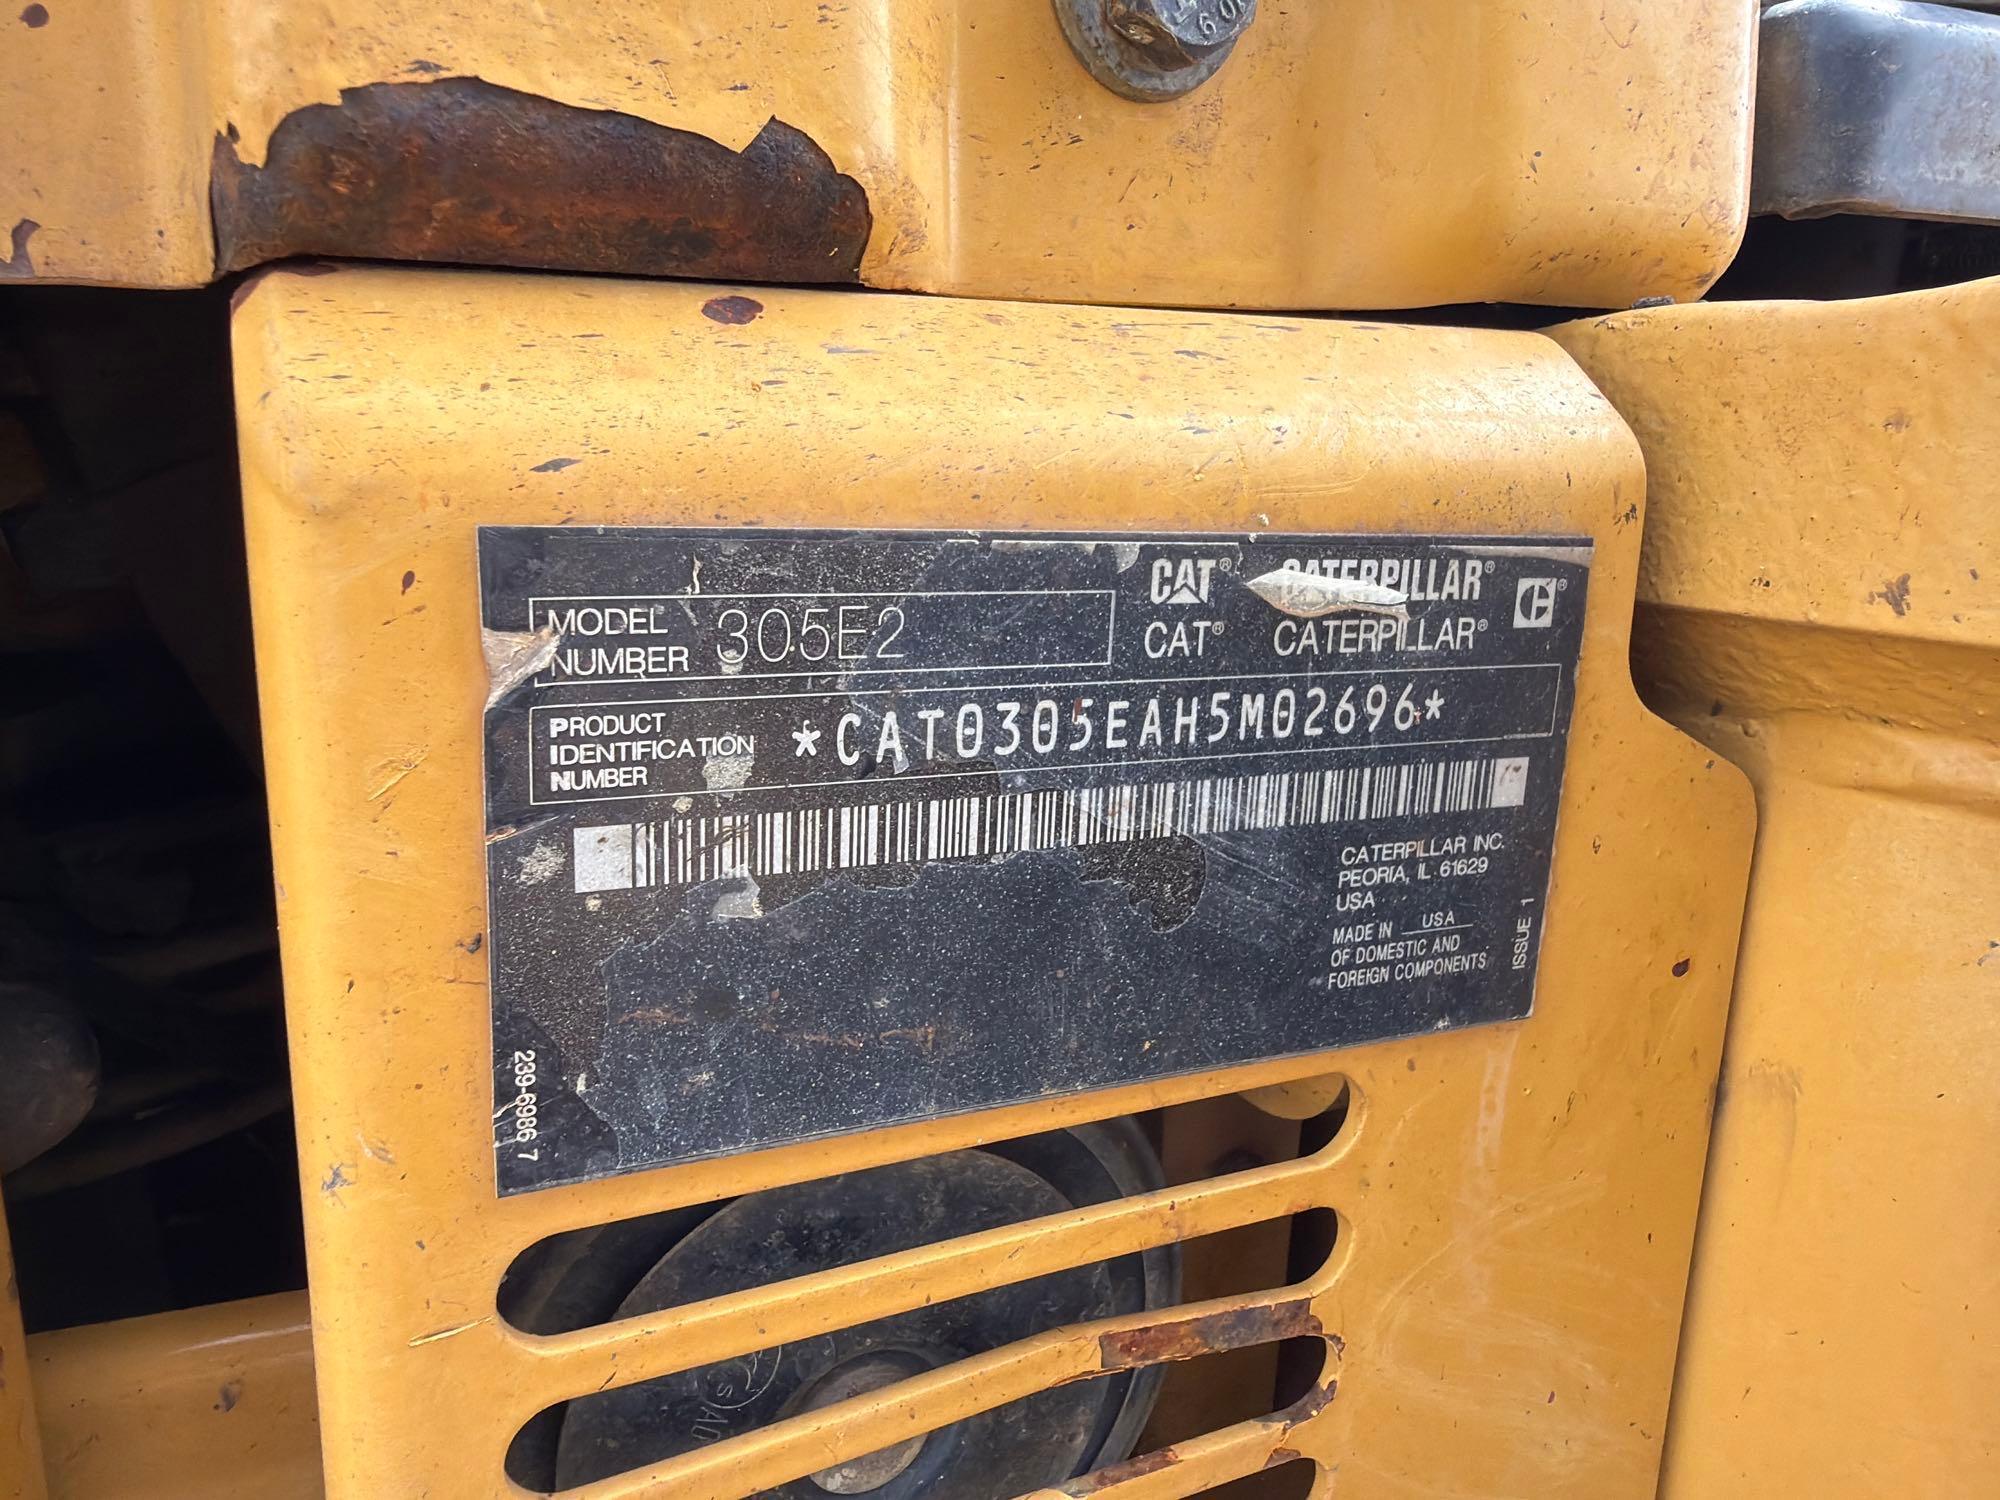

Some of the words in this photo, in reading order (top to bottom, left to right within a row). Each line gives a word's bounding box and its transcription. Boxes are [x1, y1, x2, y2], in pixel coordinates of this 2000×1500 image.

[548, 607, 668, 636] MODEL
[716, 604, 906, 665] 305E2
[551, 645, 690, 676] NUMBER
[550, 712, 666, 738] PRODUCT
[550, 734, 755, 765] IDENTIFICATION
[550, 766, 648, 792] NUMBER
[1341, 836, 1467, 866] CATERPILLAR
[1473, 832, 1505, 851] INC.
[1338, 866, 1410, 888] PEORIA,
[1418, 867, 1431, 880] IL
[1440, 857, 1489, 878] 61629
[1336, 891, 1375, 912] USA
[1521, 898, 1535, 907] 1
[1332, 924, 1373, 945] MADE
[1379, 922, 1393, 939] IN
[1422, 911, 1455, 929] USA
[1512, 916, 1532, 970] ISSUE
[1331, 949, 1350, 968] OF
[1356, 939, 1427, 965] DOMESTIC
[1432, 934, 1461, 952] AND
[1328, 967, 1389, 990] FOREIGN
[1395, 951, 1487, 981] COMPONENTS
